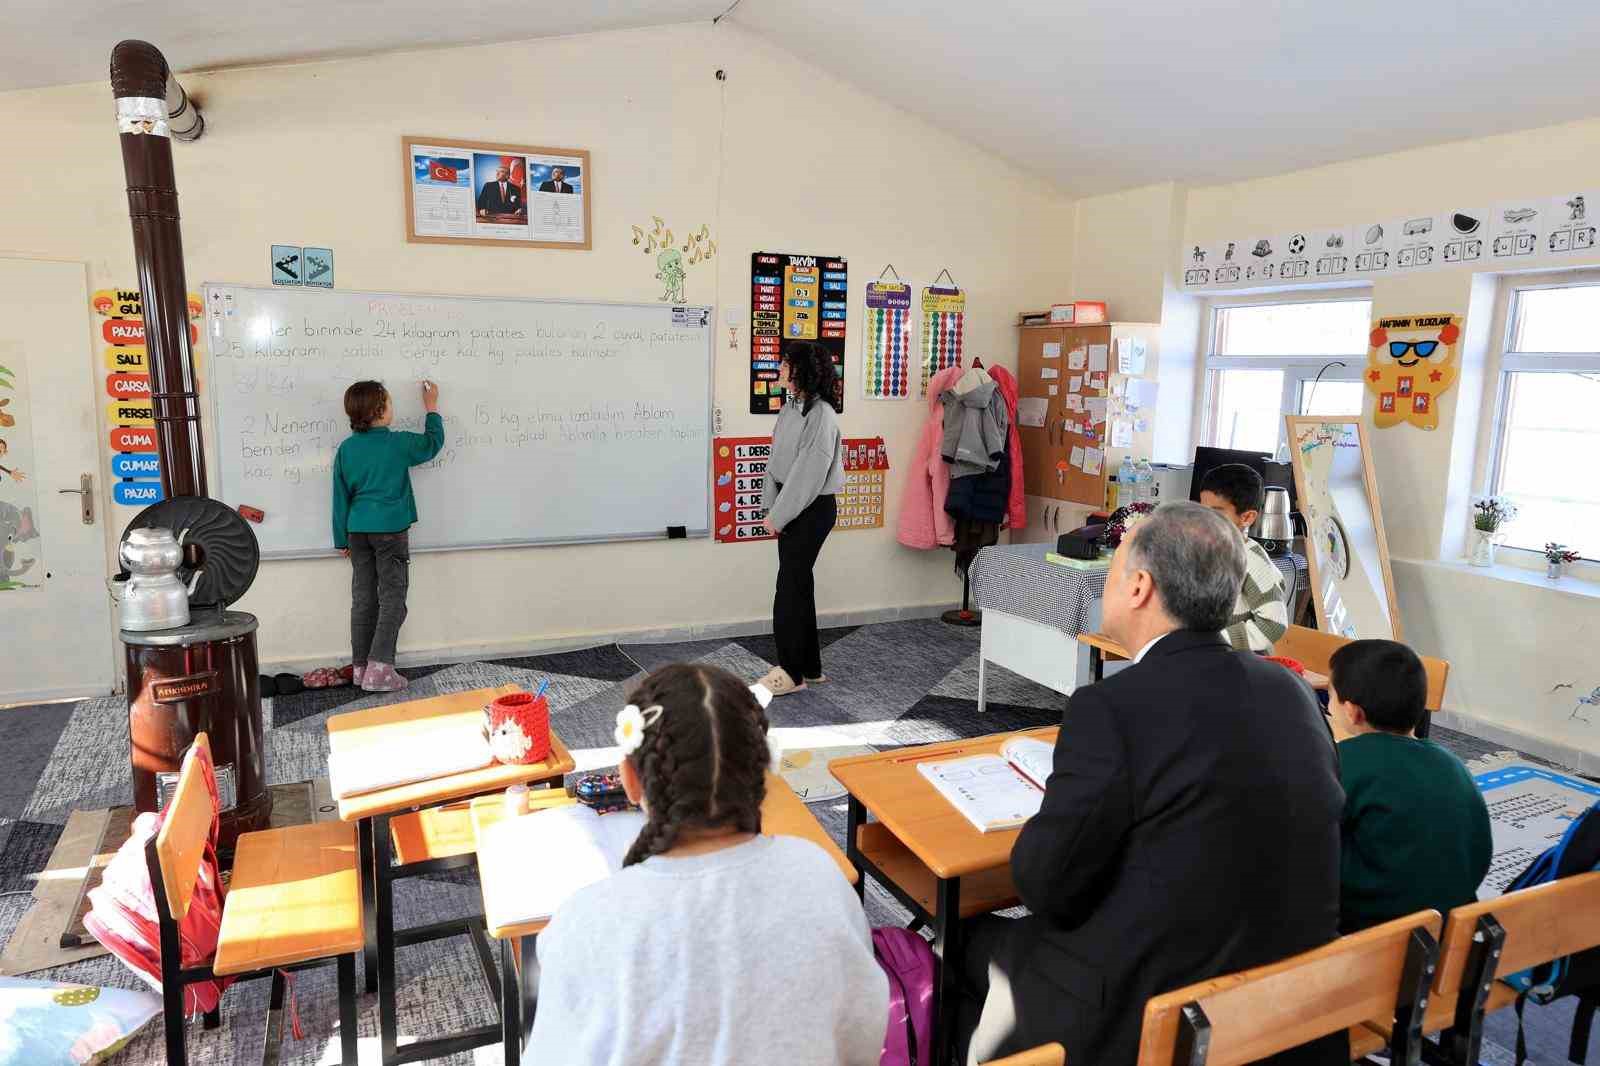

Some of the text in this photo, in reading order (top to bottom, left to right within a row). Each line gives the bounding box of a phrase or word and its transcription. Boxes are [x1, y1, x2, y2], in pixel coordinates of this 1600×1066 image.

[116, 354, 142, 366] SALI
[120, 434, 153, 446] CUMA
[737, 446, 770, 457] 1. DERS
[737, 463, 746, 473] 2.
[738, 480, 746, 490] 3.
[124, 488, 157, 500] PAZAR
[738, 496, 747, 506] 4.
[738, 511, 747, 521] 5.
[738, 528, 747, 537] 6.
